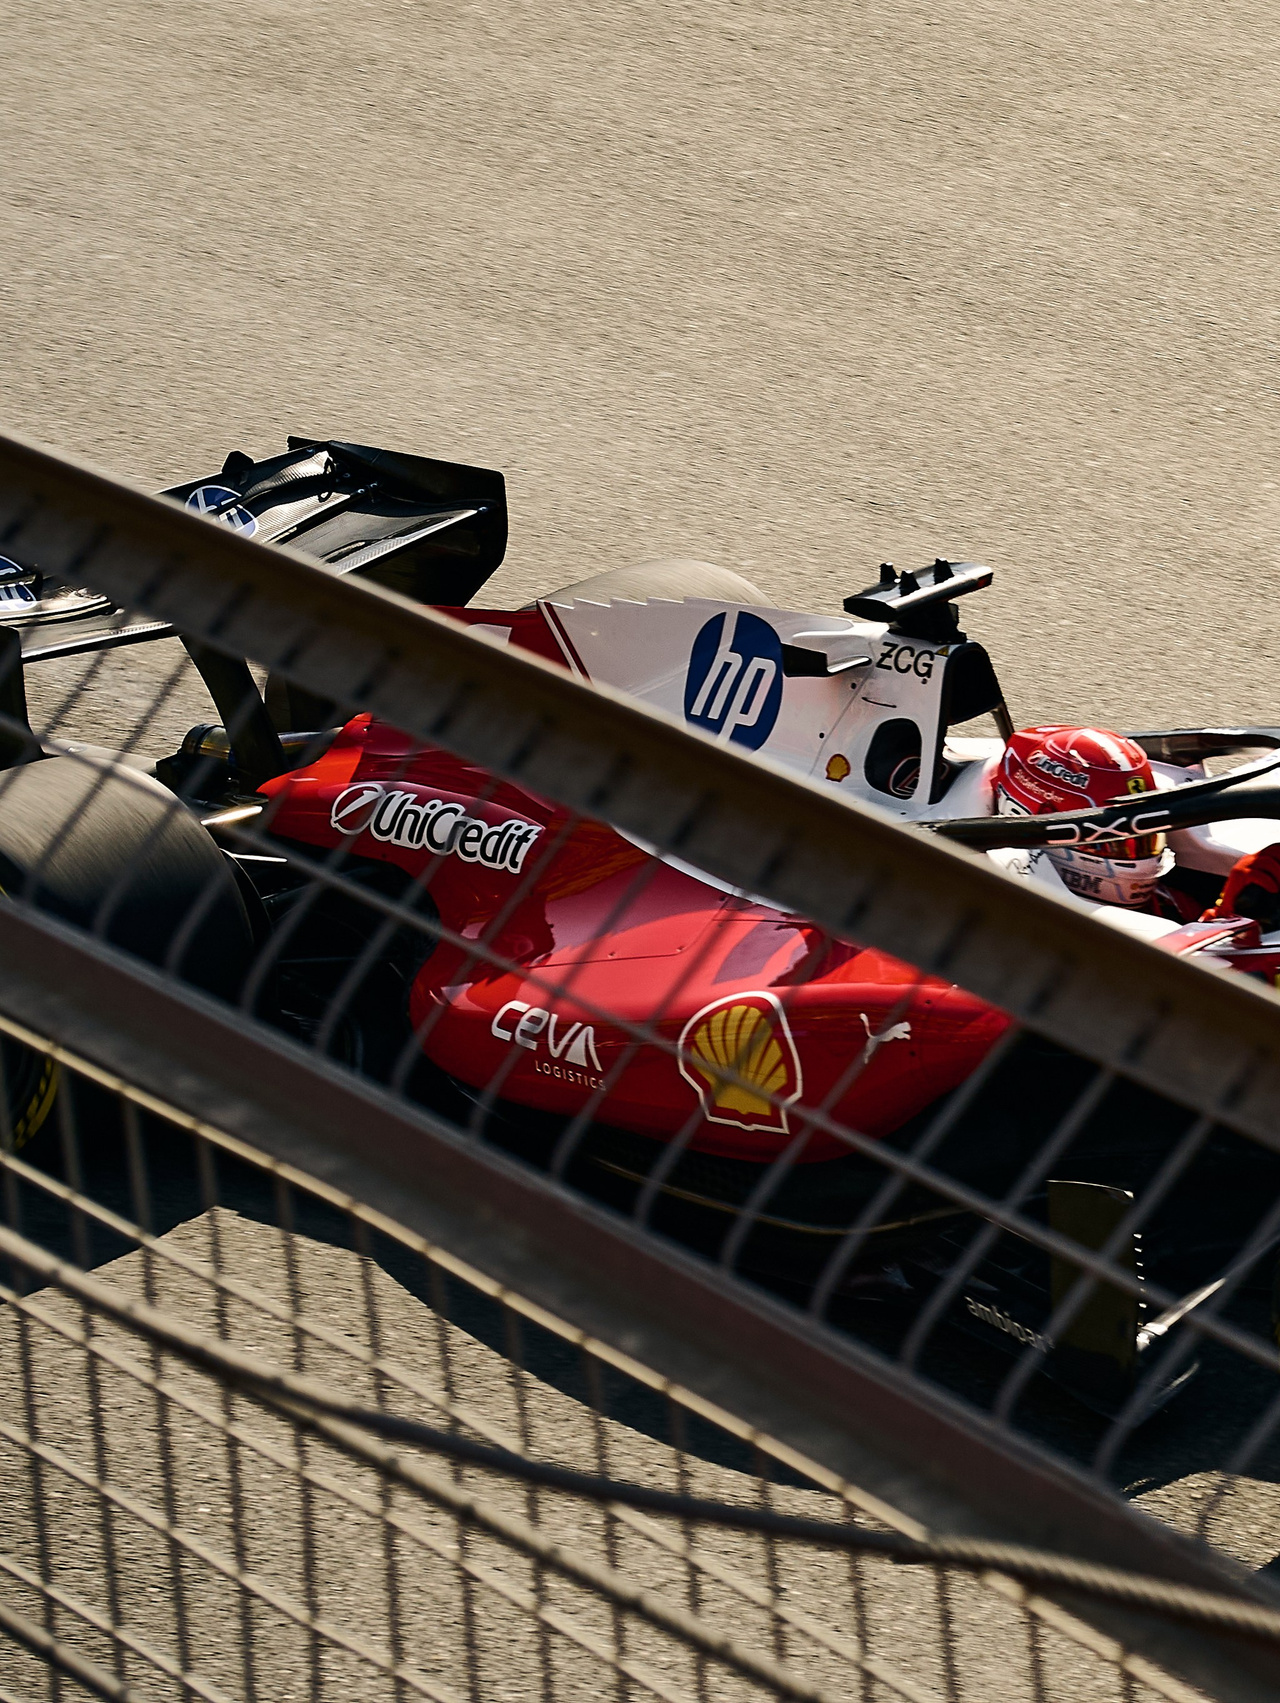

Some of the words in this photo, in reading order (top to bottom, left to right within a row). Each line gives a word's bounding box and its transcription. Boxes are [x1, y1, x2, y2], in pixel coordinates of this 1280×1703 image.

[875, 641, 936, 678] ZCG
[689, 610, 778, 745] hp
[1013, 769, 1065, 804] Bitdefender
[1035, 756, 1091, 790] UniCredit
[370, 790, 544, 874] UniCredit
[1046, 809, 1173, 845] DXC
[1060, 867, 1104, 894] IBM
[534, 1060, 607, 1091] LOGISTICS
